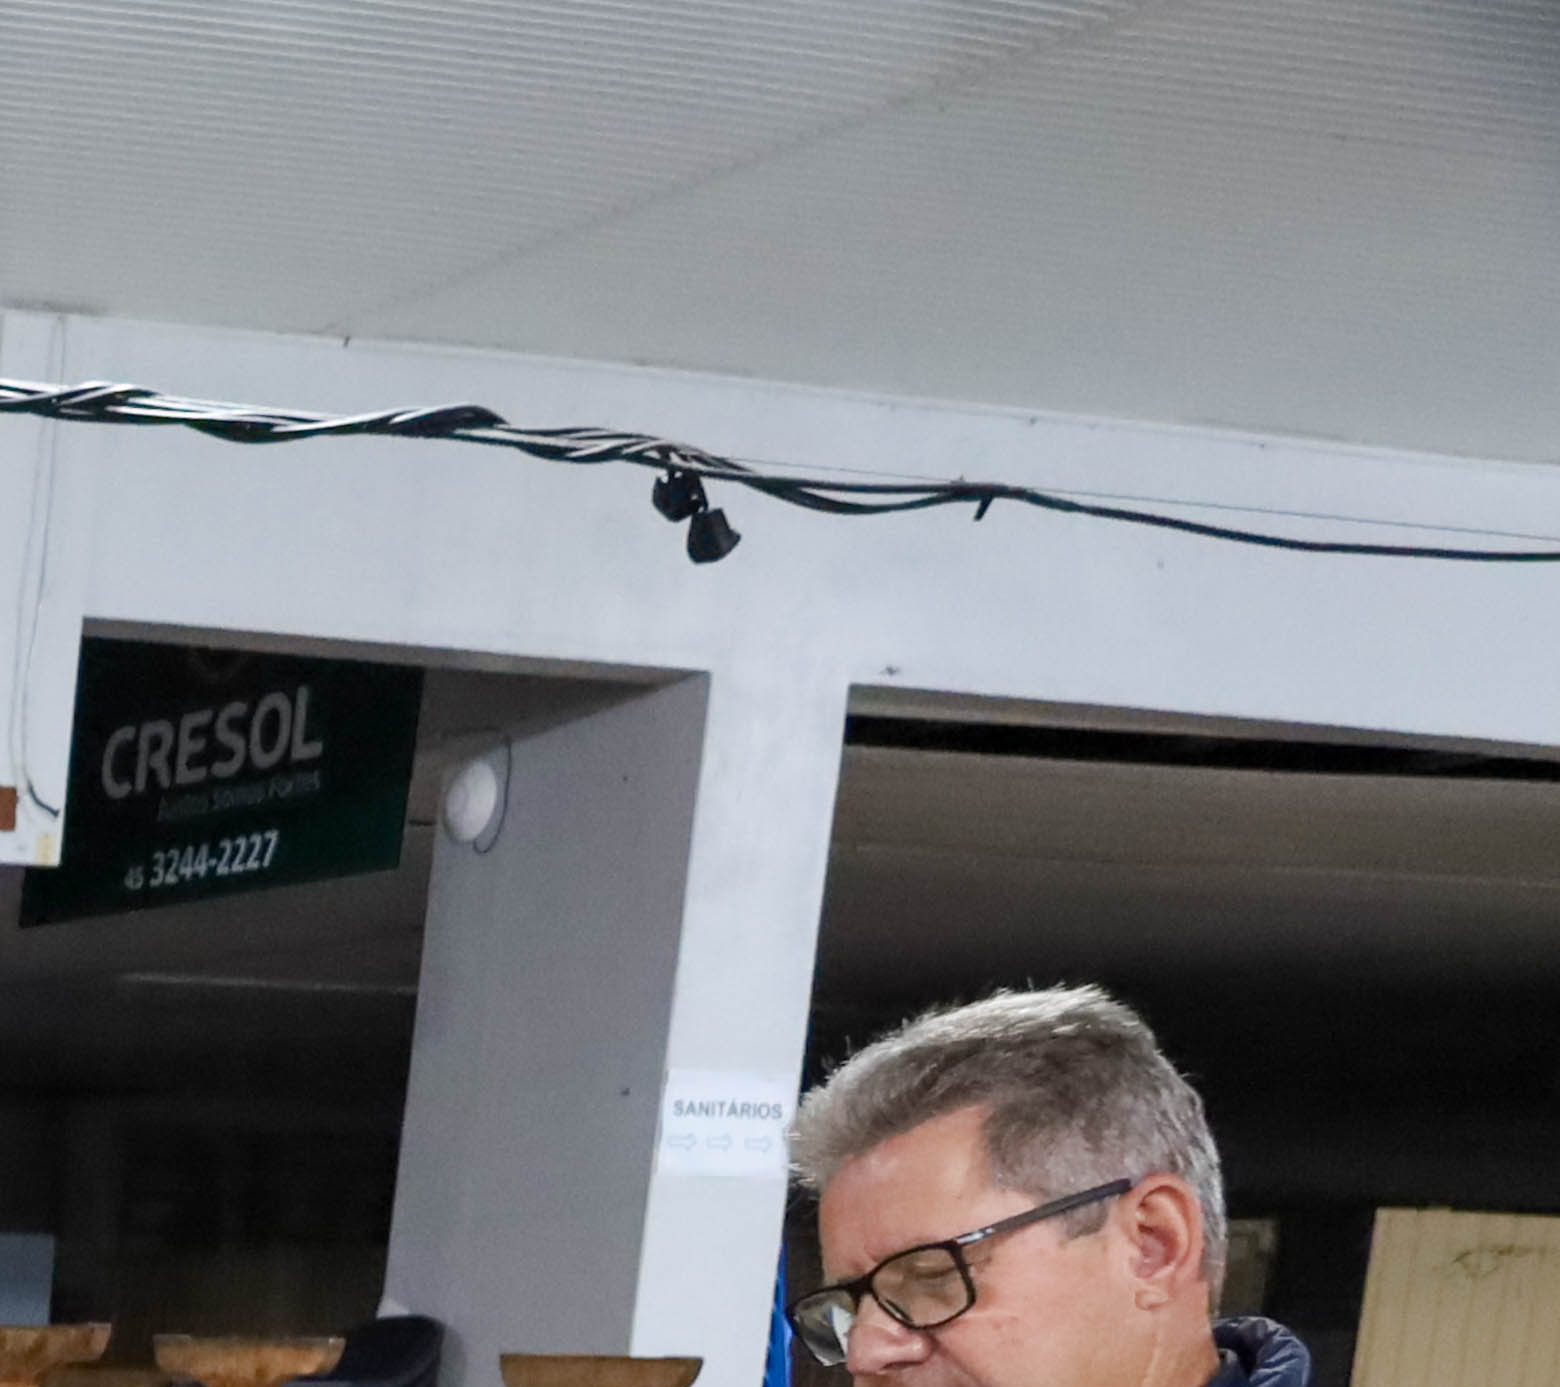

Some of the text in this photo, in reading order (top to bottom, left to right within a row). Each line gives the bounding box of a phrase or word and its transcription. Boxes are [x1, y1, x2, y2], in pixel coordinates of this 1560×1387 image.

[101, 684, 324, 800] CRESOL
[148, 828, 280, 889] 3244-2227
[672, 1099, 783, 1120] SANITÁRIOS
